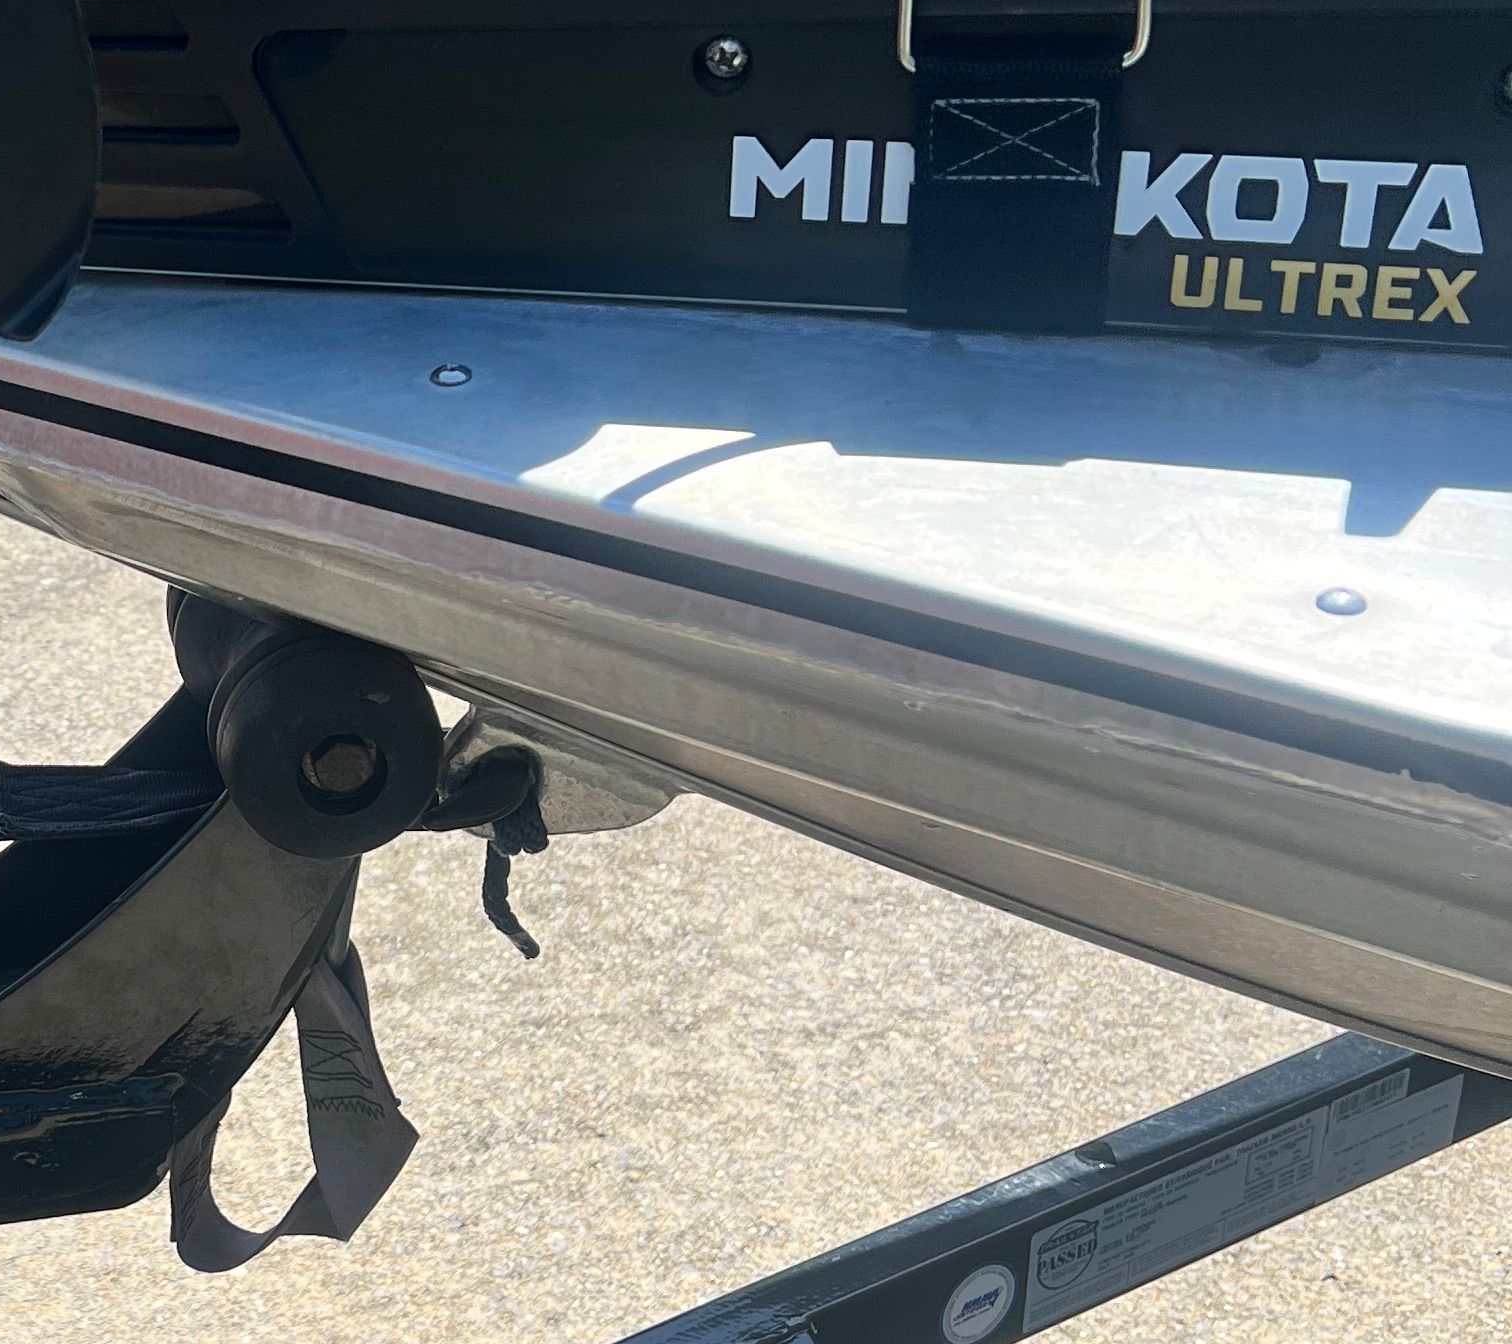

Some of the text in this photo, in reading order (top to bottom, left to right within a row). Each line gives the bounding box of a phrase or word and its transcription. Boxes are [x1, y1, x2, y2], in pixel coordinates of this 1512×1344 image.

[729, 135, 1484, 254] MI KOTA
[1169, 254, 1477, 325] ULTREX
[1040, 1238, 1098, 1273] PASSED
